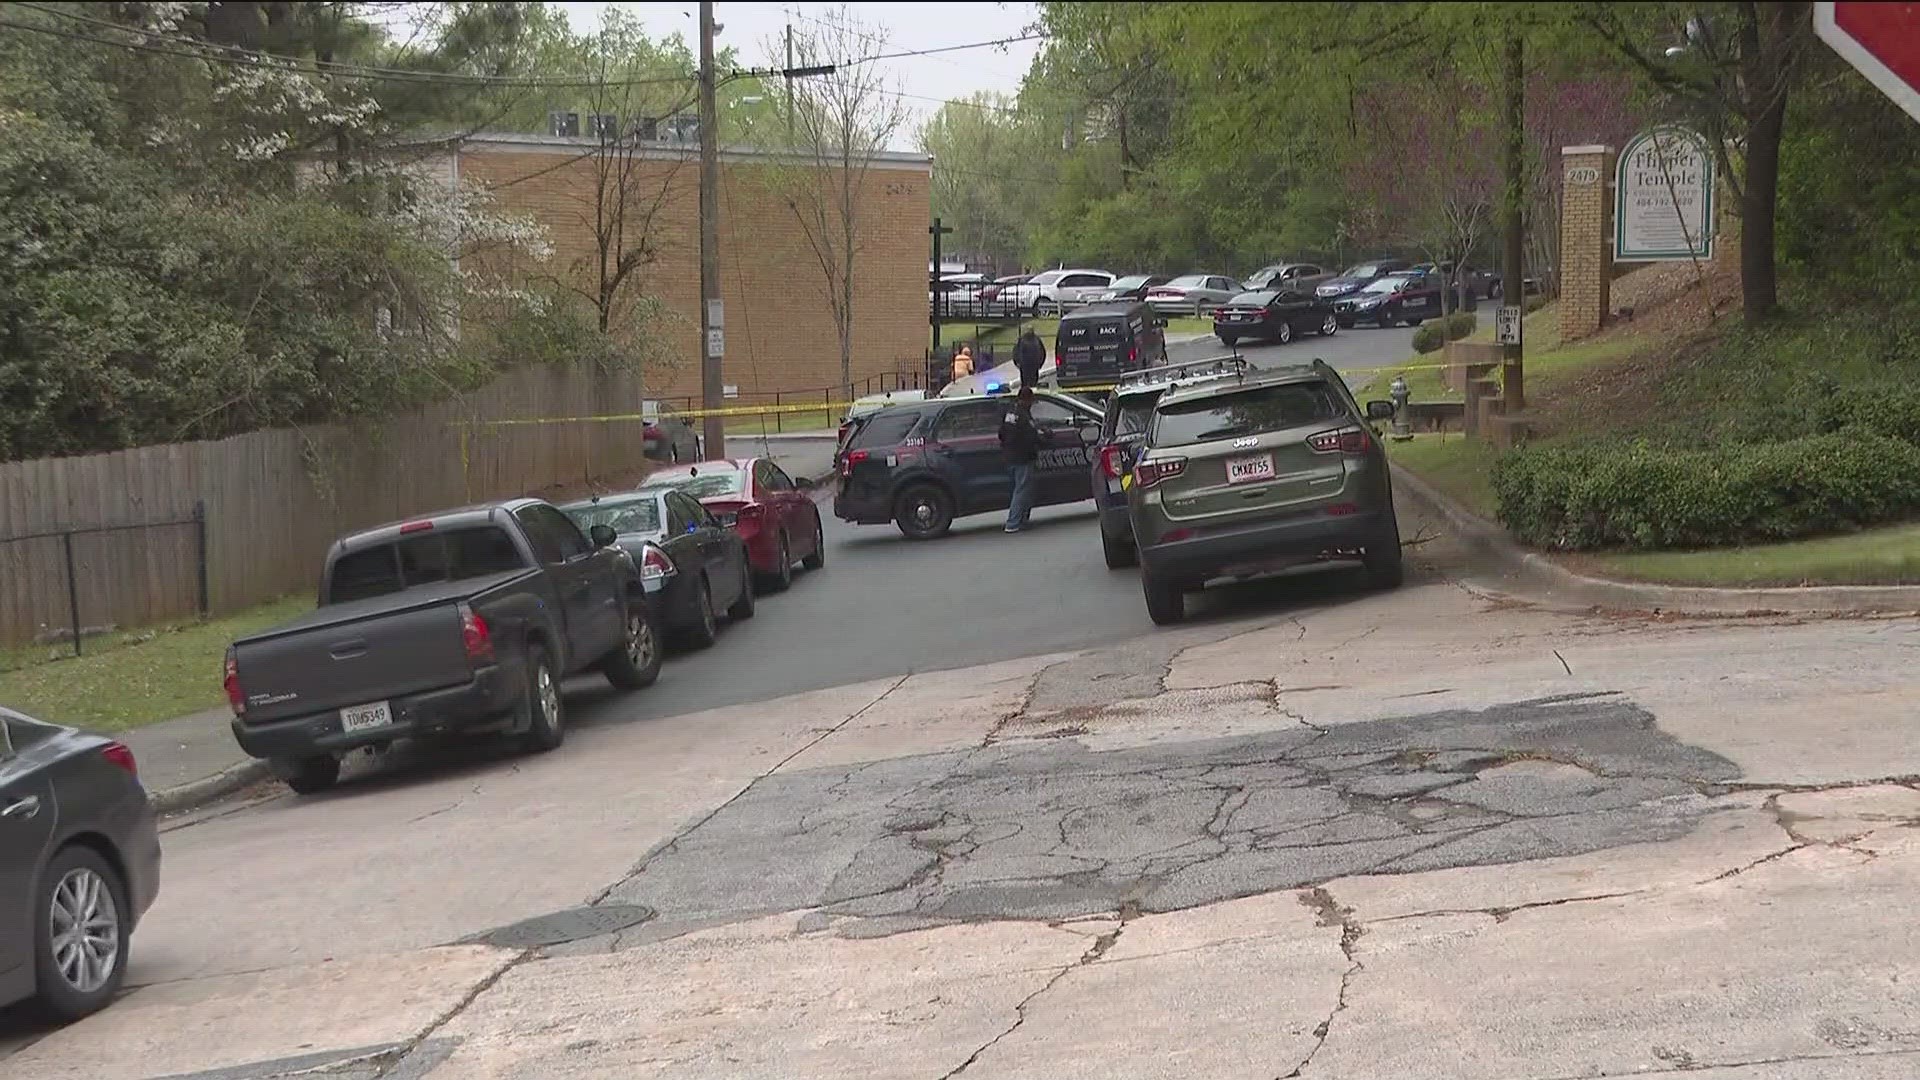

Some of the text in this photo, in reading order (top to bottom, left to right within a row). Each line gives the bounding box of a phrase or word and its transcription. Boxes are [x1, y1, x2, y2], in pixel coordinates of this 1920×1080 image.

[1569, 169, 1596, 181] 2479
[1634, 170, 1696, 188] Temple
[1100, 326, 1117, 334] BACK
[1232, 437, 1259, 448] Jeep
[1231, 460, 1269, 477] CMX2755
